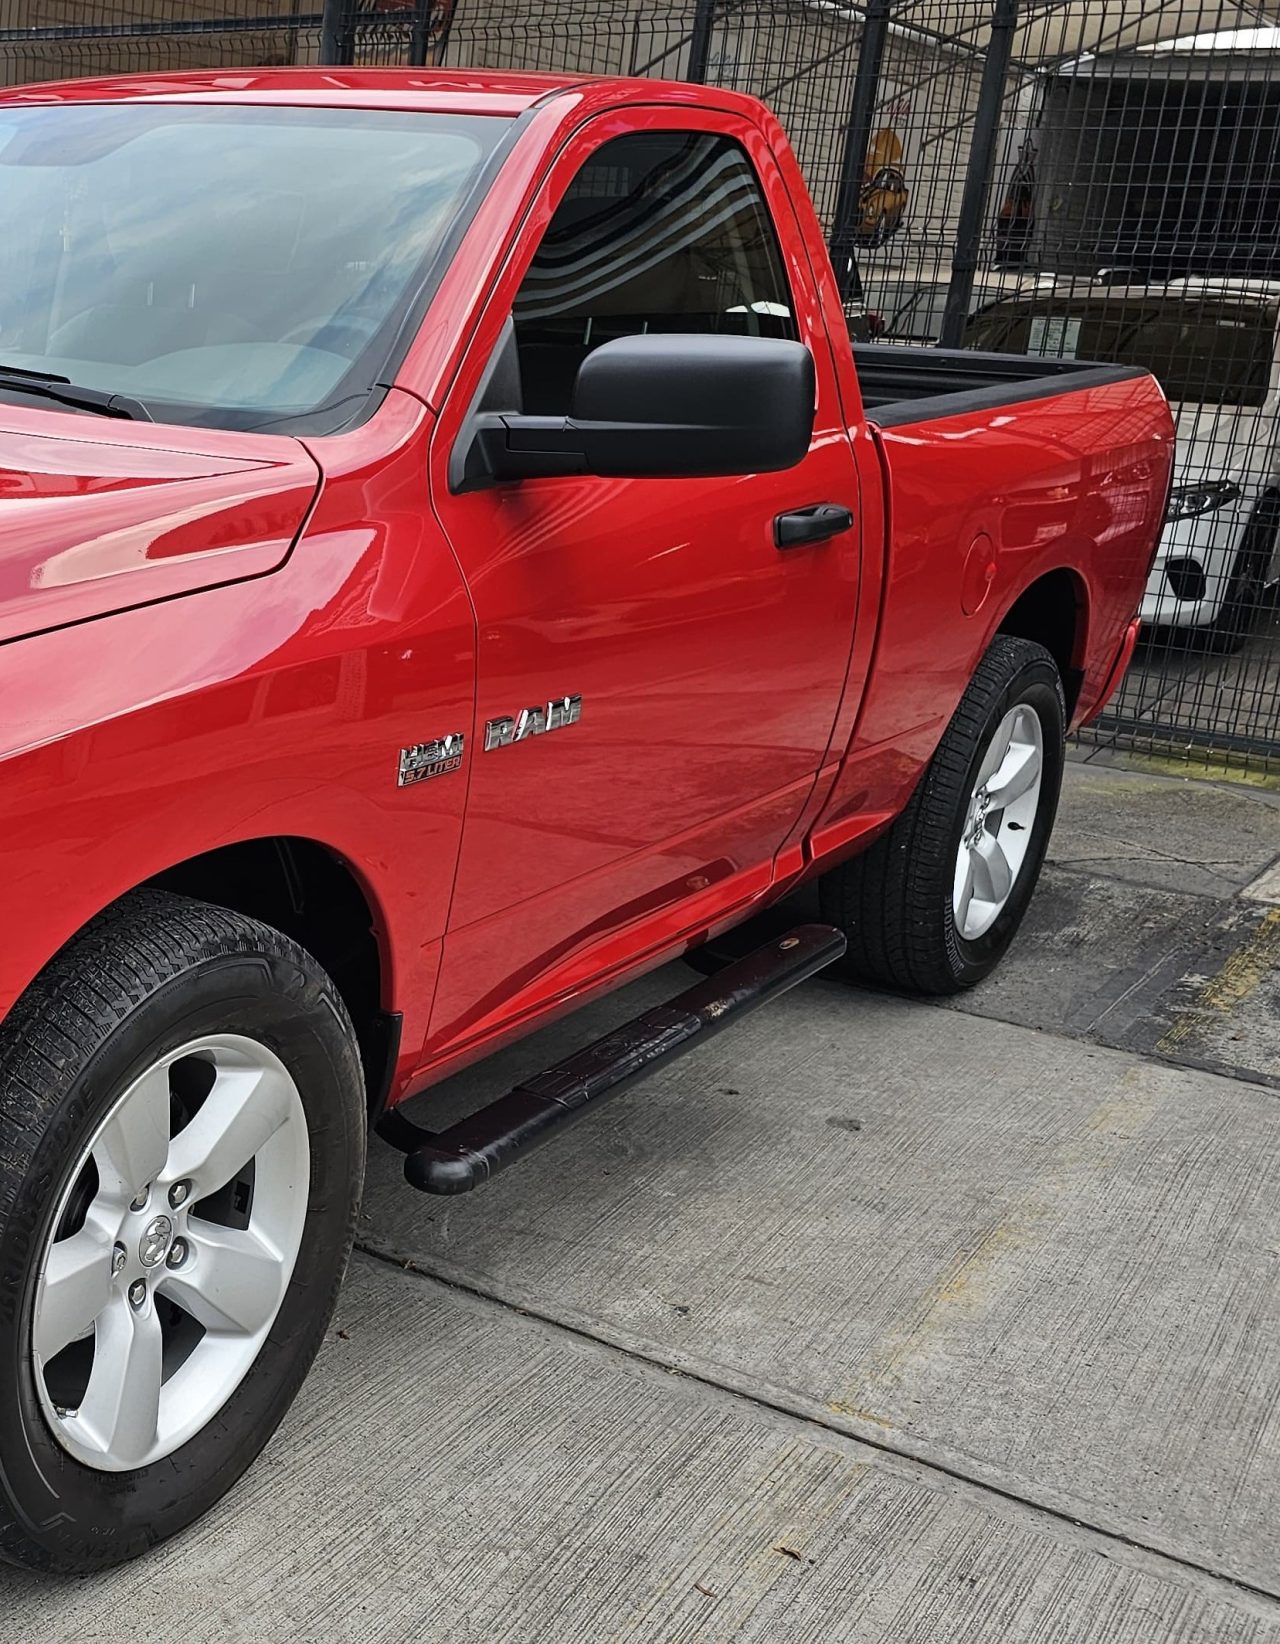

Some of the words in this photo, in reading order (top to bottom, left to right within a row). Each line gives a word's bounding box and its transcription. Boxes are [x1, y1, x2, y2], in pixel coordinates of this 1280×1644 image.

[484, 693, 583, 751] RAM
[400, 732, 464, 770] HEMI
[404, 768, 425, 783] 5.7
[426, 756, 461, 777] LITER
